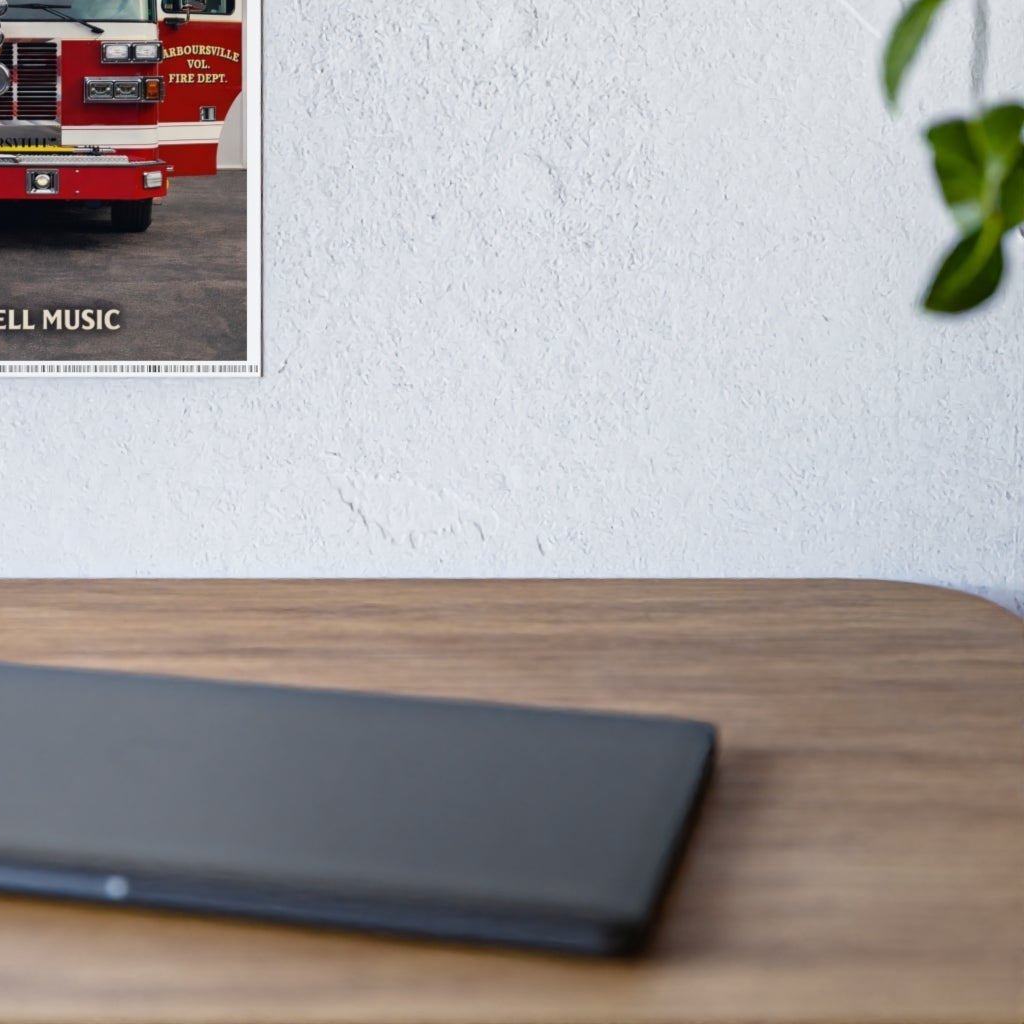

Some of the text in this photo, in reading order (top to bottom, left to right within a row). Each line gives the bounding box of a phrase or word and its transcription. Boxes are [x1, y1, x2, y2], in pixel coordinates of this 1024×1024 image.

[163, 44, 240, 63] ARBOURSVILLE
[186, 59, 211, 69] VOL.
[168, 73, 228, 84] FIRE DEPT.
[42, 308, 121, 331] MUSIC
